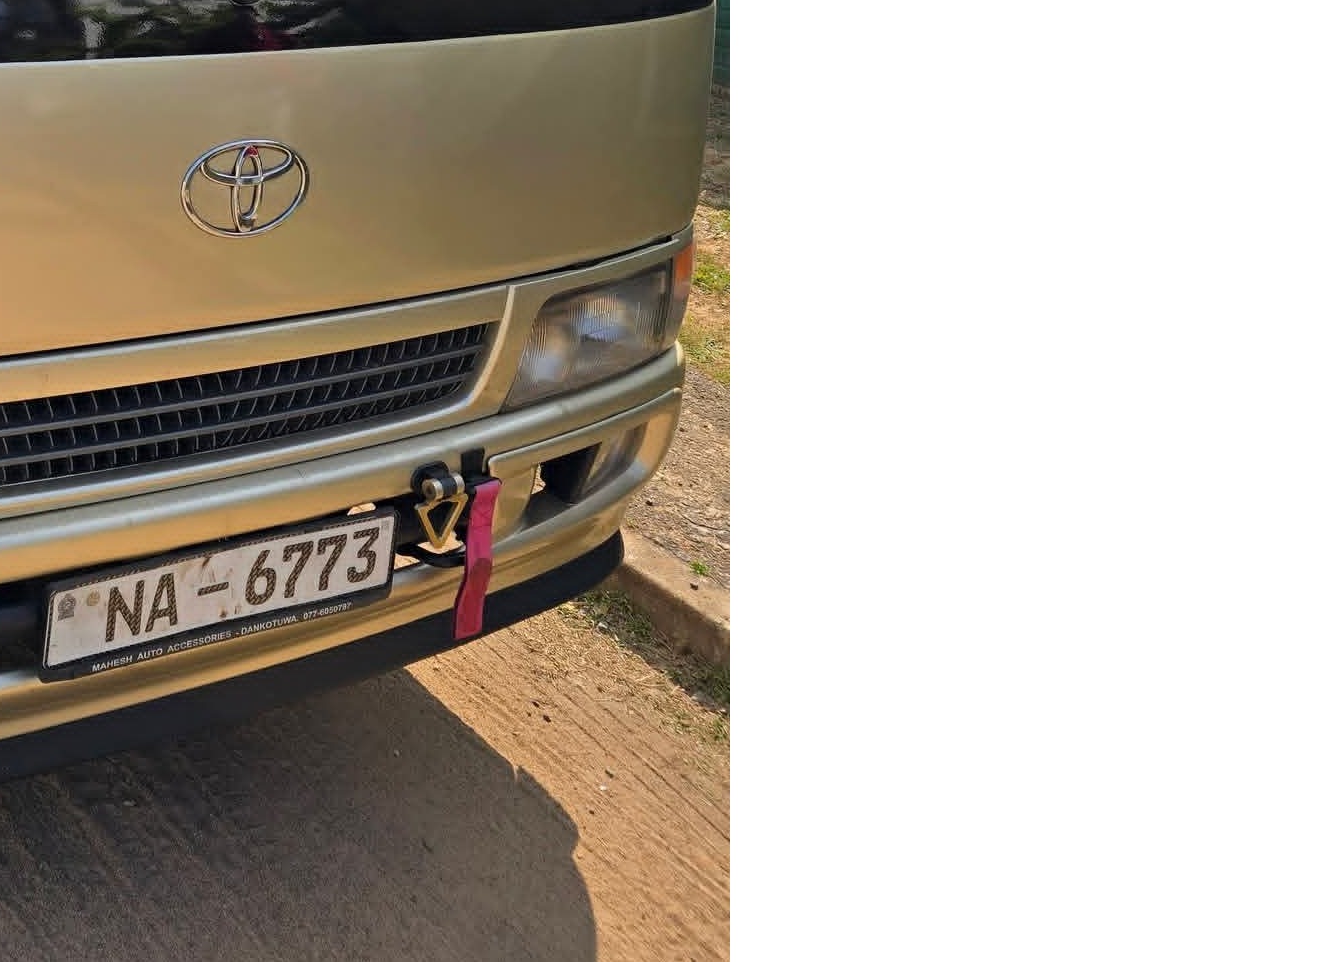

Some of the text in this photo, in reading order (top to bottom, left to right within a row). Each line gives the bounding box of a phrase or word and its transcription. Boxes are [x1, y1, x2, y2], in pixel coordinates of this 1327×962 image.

[105, 572, 179, 643] NA
[244, 527, 380, 606] 6773
[92, 655, 133, 672] MAHESH
[137, 648, 164, 661] AUTO
[167, 630, 232, 653] ACCESSORIES
